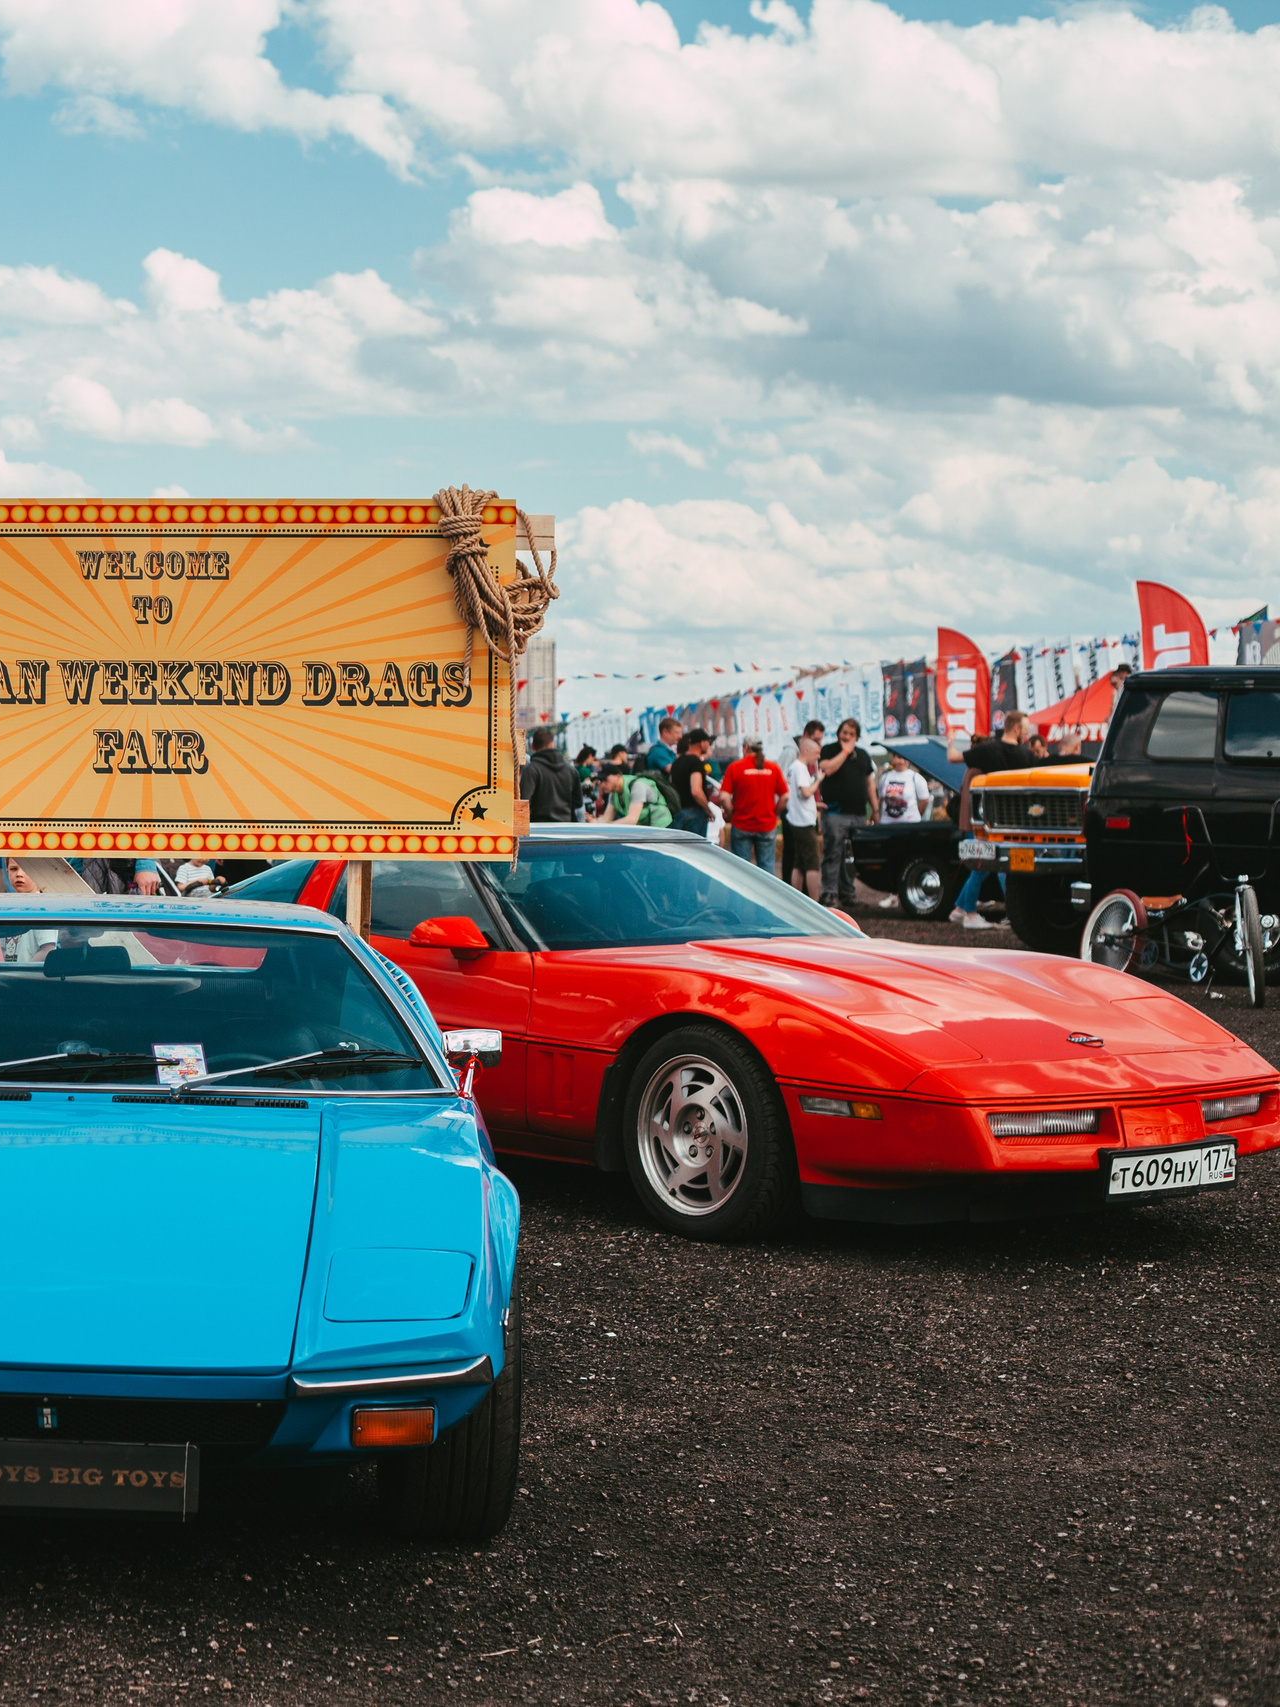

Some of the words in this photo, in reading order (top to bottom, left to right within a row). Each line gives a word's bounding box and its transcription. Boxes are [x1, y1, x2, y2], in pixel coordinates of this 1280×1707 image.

[76, 549, 230, 580] WELCOME
[131, 594, 174, 625] TO
[57, 659, 293, 706] WEEKEND
[300, 660, 473, 708] DRAGS
[91, 728, 209, 775] FAIR
[1203, 1149, 1231, 1171] 177
[1208, 1170, 1223, 1180] RUS
[49, 1466, 104, 1486] BIG
[111, 1469, 186, 1489] TOYS
